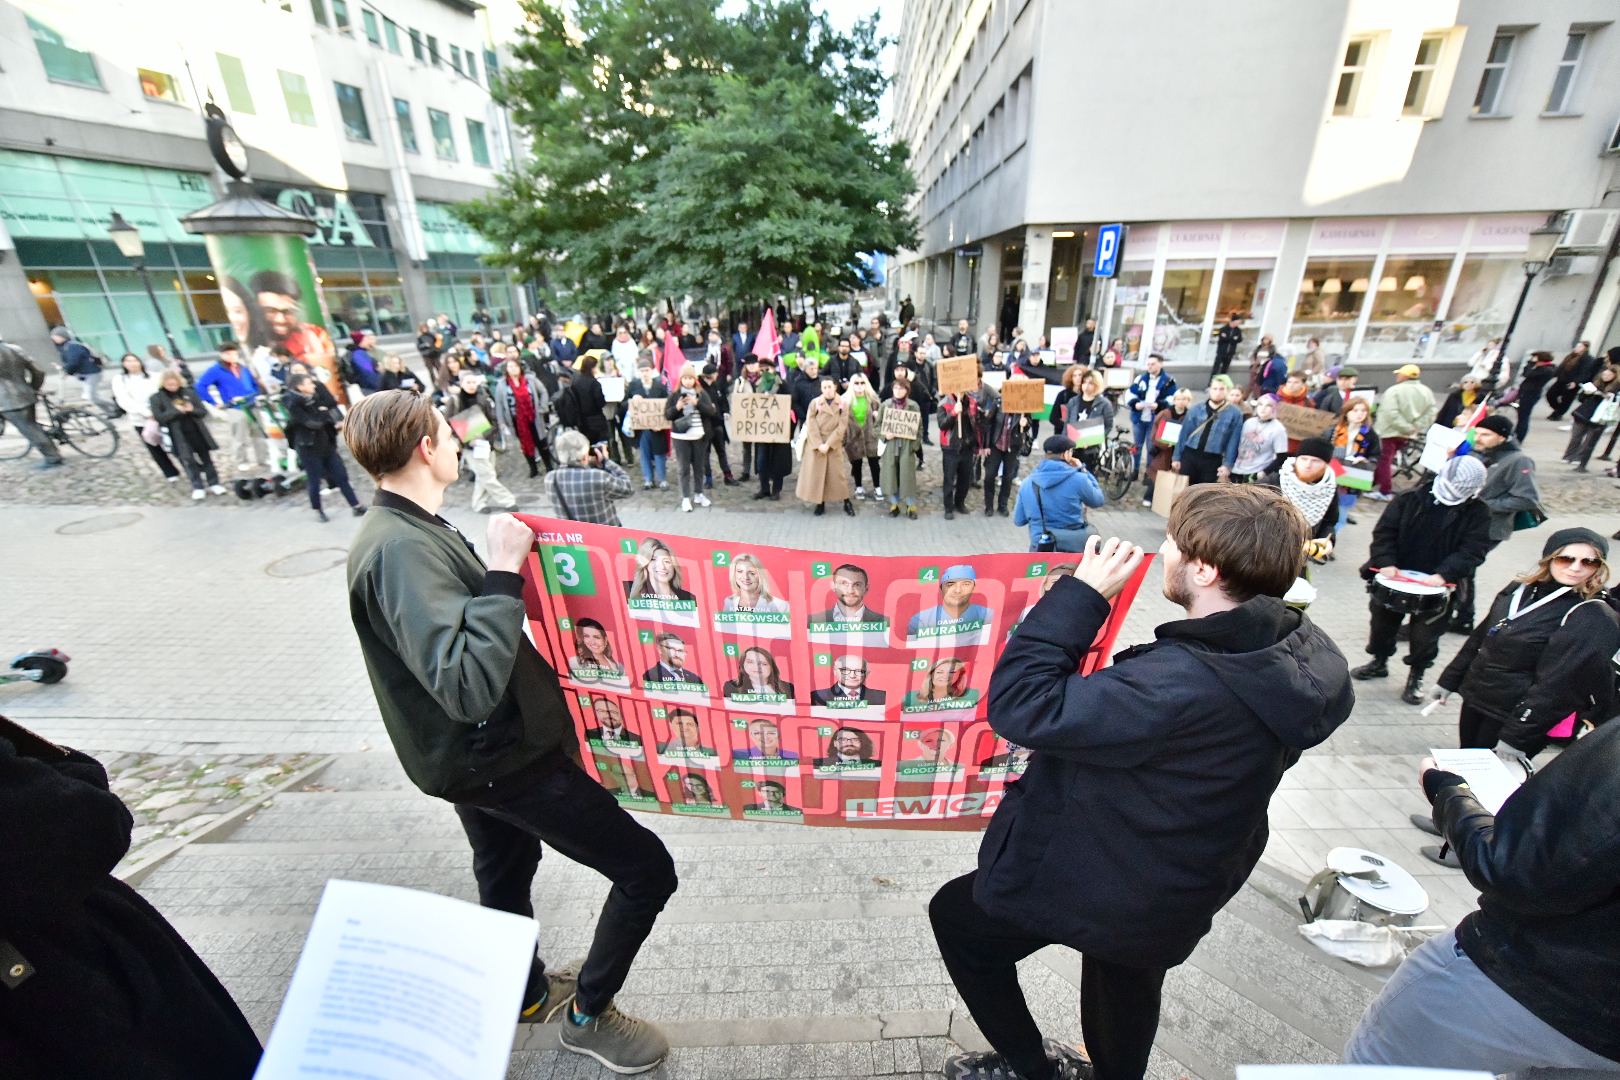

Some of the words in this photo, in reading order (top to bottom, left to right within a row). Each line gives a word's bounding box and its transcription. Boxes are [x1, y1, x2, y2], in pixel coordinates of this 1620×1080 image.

[1098, 231, 1115, 271] P
[631, 402, 661, 413] WOLN
[741, 396, 780, 409] GAZA
[746, 410, 755, 418] IS
[764, 410, 770, 418] A
[885, 410, 918, 424] WOLNA
[737, 420, 784, 435] PRISON
[534, 532, 566, 543] LISTA
[565, 533, 584, 543] NR
[625, 541, 632, 552] 1
[716, 553, 726, 565] 2
[553, 552, 580, 587] 3
[816, 565, 826, 576] 3
[1031, 564, 1043, 576] 5
[923, 569, 934, 581] 4
[631, 599, 692, 611] UEBERHAN
[714, 612, 789, 624] KRETKOWSKA
[937, 617, 964, 626] DAWID
[561, 619, 571, 629] 6
[813, 622, 884, 633] MAJEWSKI
[918, 621, 981, 636] MURAWA
[642, 632, 649, 642] 7
[726, 645, 735, 655] 8
[818, 655, 828, 665] 9
[912, 659, 928, 670] 10
[573, 669, 620, 679] TRZECIAK
[644, 682, 707, 692] GARCZEWSKI
[578, 696, 591, 706] 12
[732, 693, 785, 702] MAJERYK
[828, 701, 867, 709] KANIA
[905, 701, 973, 713] OWSIANNA
[653, 708, 666, 718] 13
[733, 719, 747, 729] 14
[818, 727, 832, 736] 15
[904, 731, 920, 739] 16
[734, 759, 799, 767] ANTKOWIAK
[820, 763, 875, 773] GÓRALSKI
[903, 766, 957, 775] GRODZKA
[667, 772, 679, 781] 19
[856, 794, 1002, 818] LEWICA
